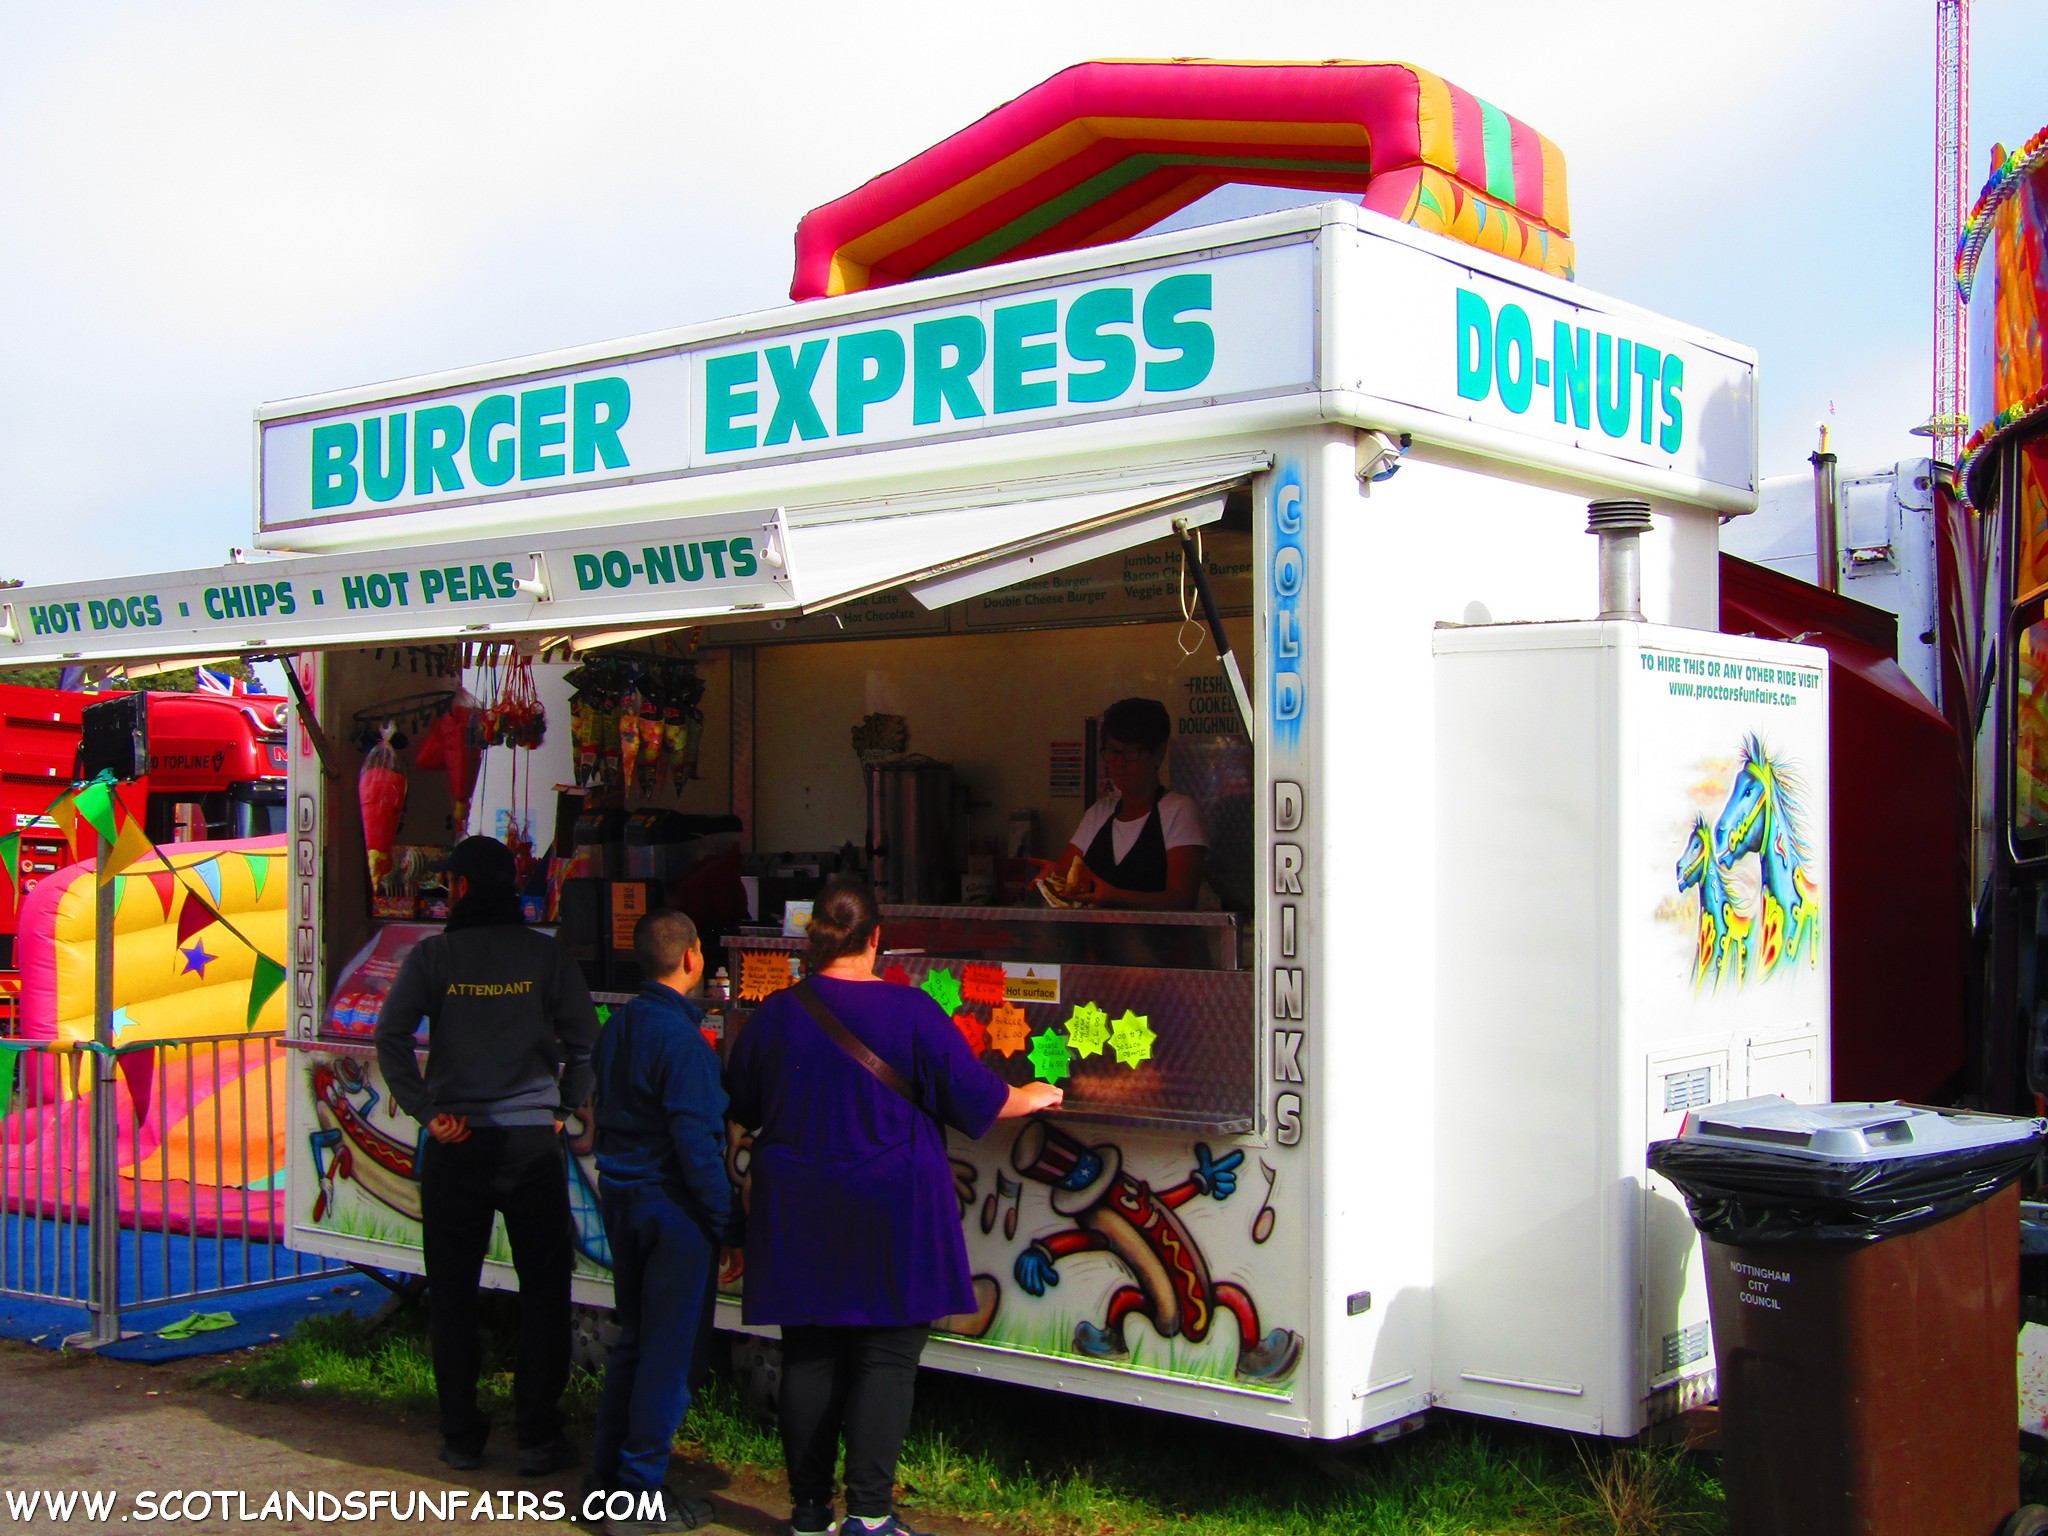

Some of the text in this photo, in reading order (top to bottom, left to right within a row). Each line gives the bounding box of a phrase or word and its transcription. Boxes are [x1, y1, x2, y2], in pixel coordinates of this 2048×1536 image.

[1456, 287, 1684, 454] DO-NUTS
[312, 273, 1215, 509] BURGER EXPRESS
[29, 537, 759, 635] HOT DOGS CHIPS HOT PEAS DO-NUTS
[984, 590, 1107, 609] Double Cheese Burger
[1275, 484, 1304, 721] COLD
[865, 608, 915, 622] Chocolate
[1641, 653, 1819, 690] TO HIRE THIS OR ANY OTHER RIDE VISIT
[1669, 681, 1797, 707] www.proctorsfunfairs.com
[163, 754, 210, 769] TOPLINE
[297, 796, 315, 1051] DRINKS
[1274, 781, 1304, 1146] DRINKS
[447, 980, 533, 997] ATTENDANT
[1006, 986, 1055, 998] Hot surface
[1730, 1260, 1791, 1283] NOTTINGHAM
[1748, 1279, 1769, 1293] CITY
[1740, 1291, 1782, 1310] COUNCIL
